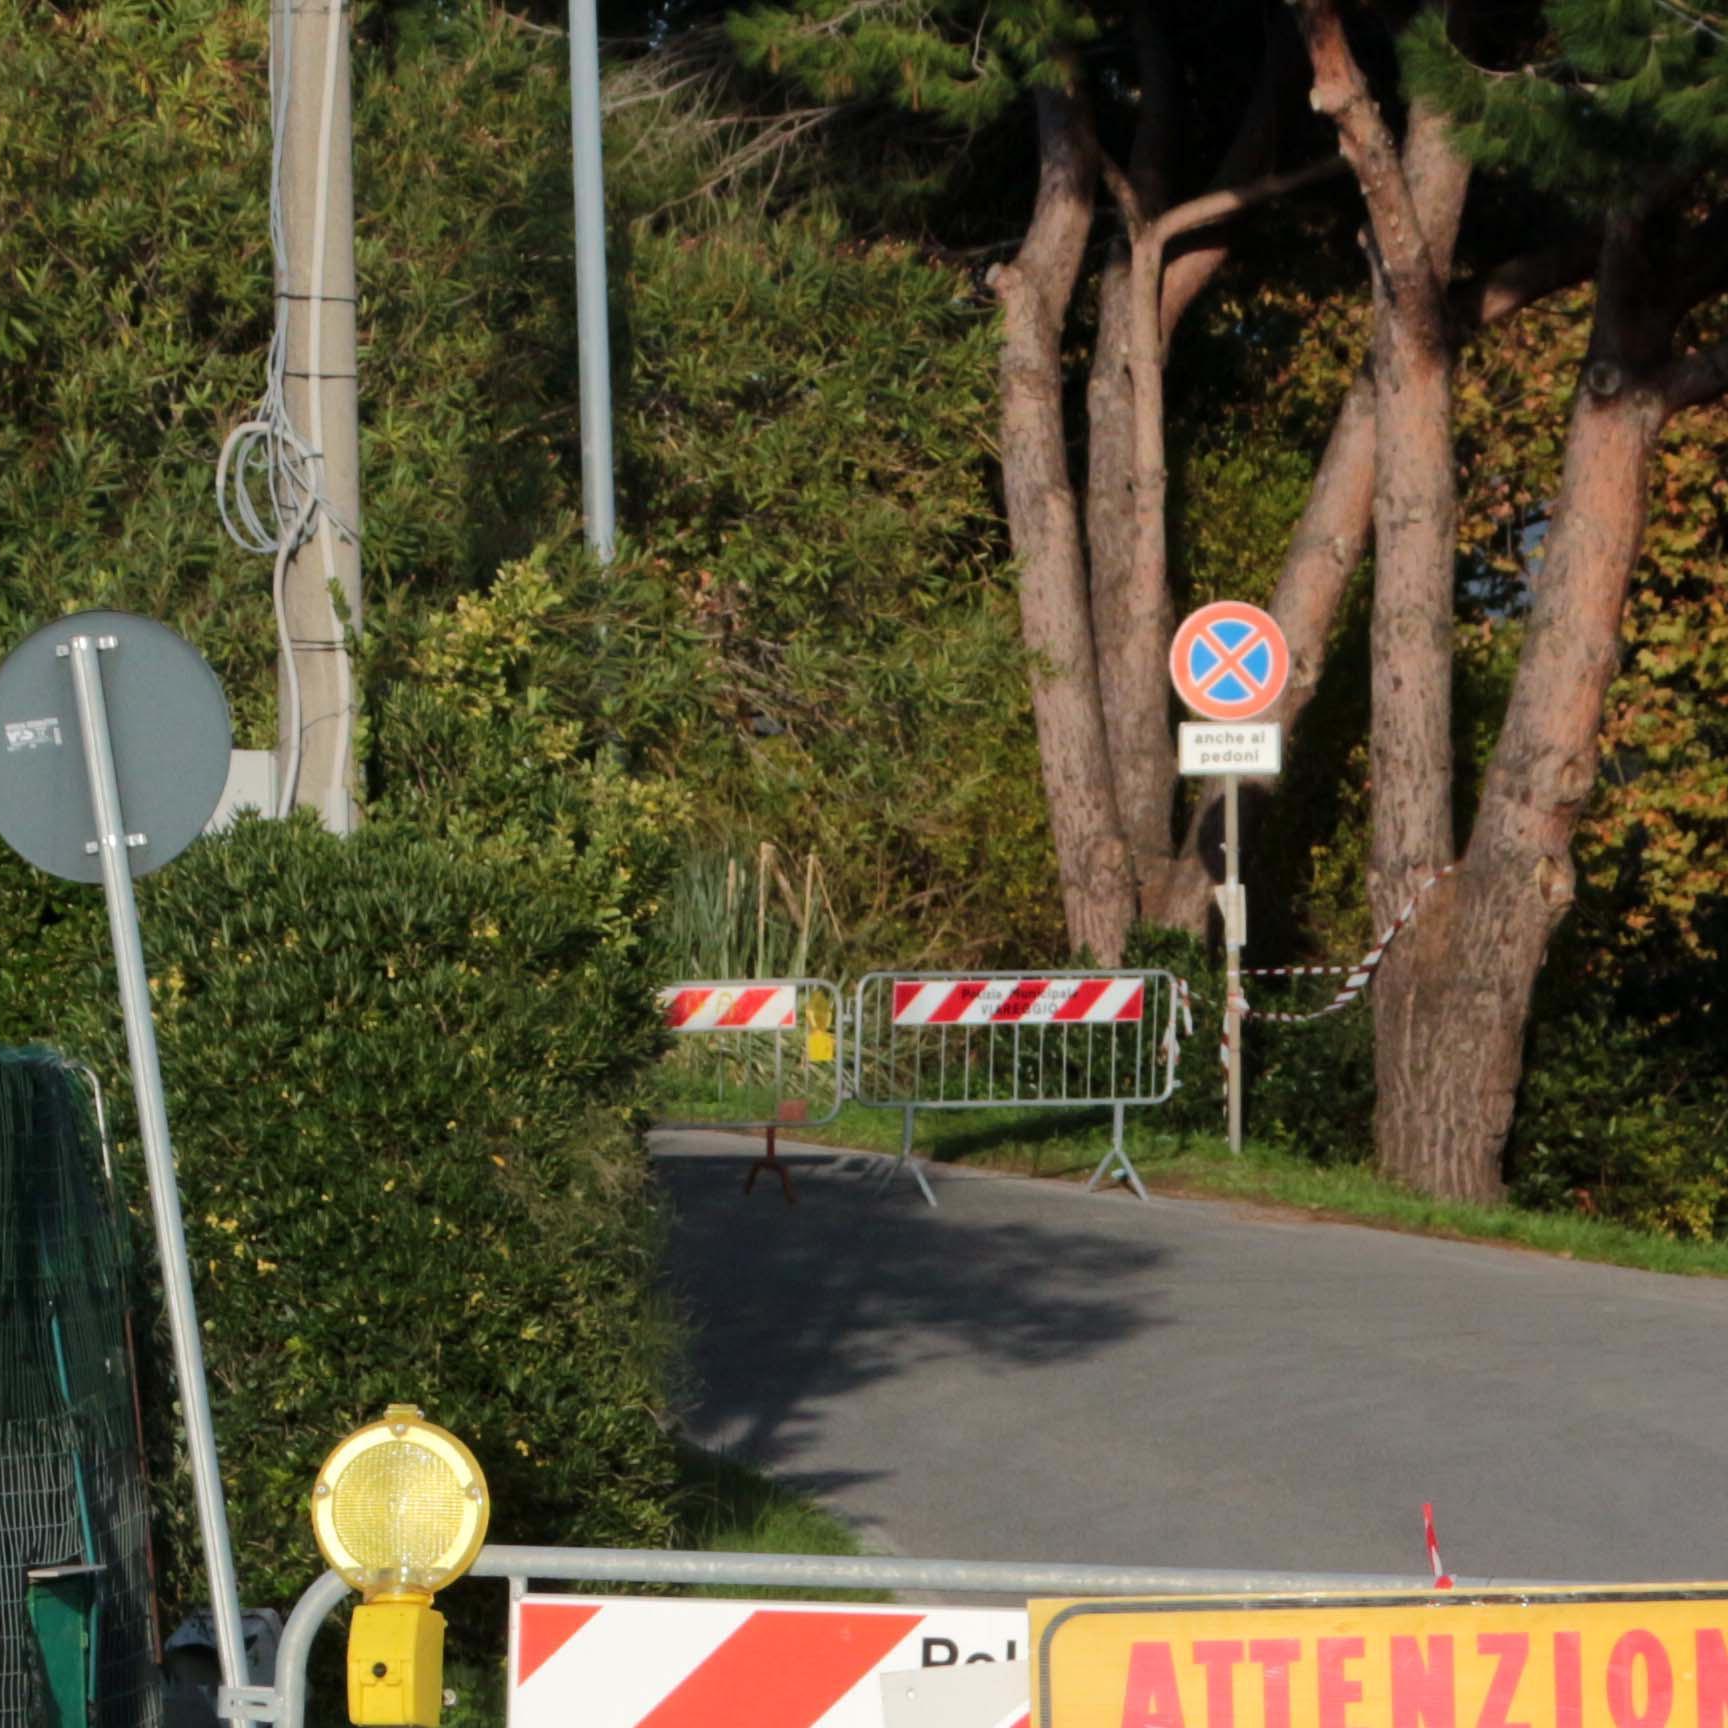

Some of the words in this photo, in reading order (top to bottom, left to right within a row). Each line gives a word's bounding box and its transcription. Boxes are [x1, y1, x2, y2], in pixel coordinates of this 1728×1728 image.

[1194, 731, 1245, 745] anche
[1200, 749, 1260, 765] pedoni
[981, 1002, 1058, 1016] VIAREGGIO
